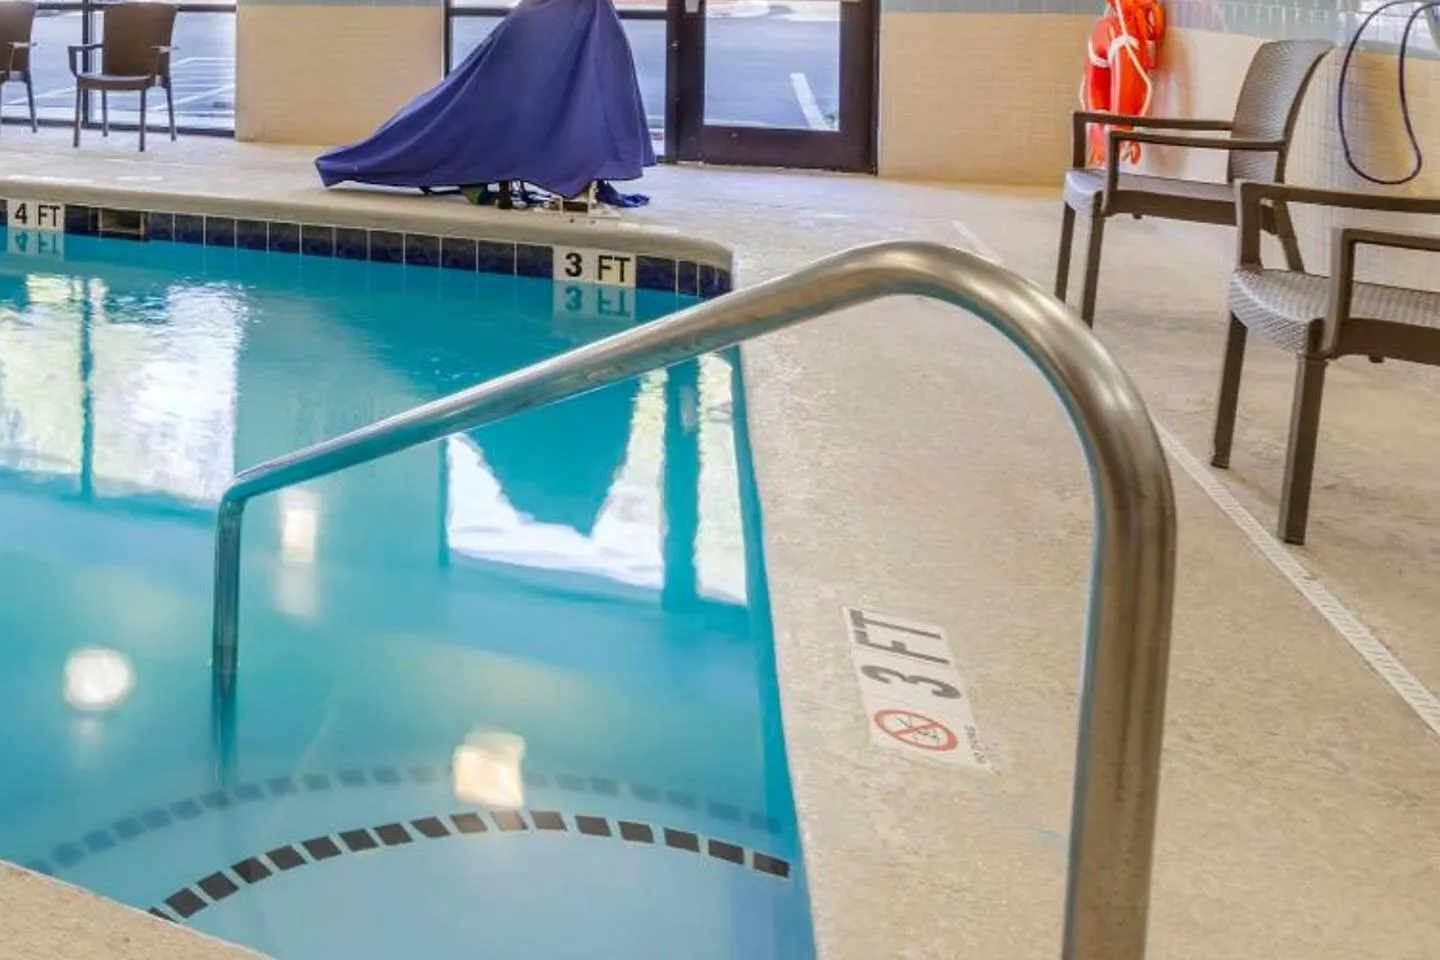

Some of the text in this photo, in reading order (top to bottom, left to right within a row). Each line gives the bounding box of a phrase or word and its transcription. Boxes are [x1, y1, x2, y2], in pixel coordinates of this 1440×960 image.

[14, 203, 60, 227] 4 FT
[565, 252, 631, 282] 3 FT
[849, 609, 962, 699] 3 FT
